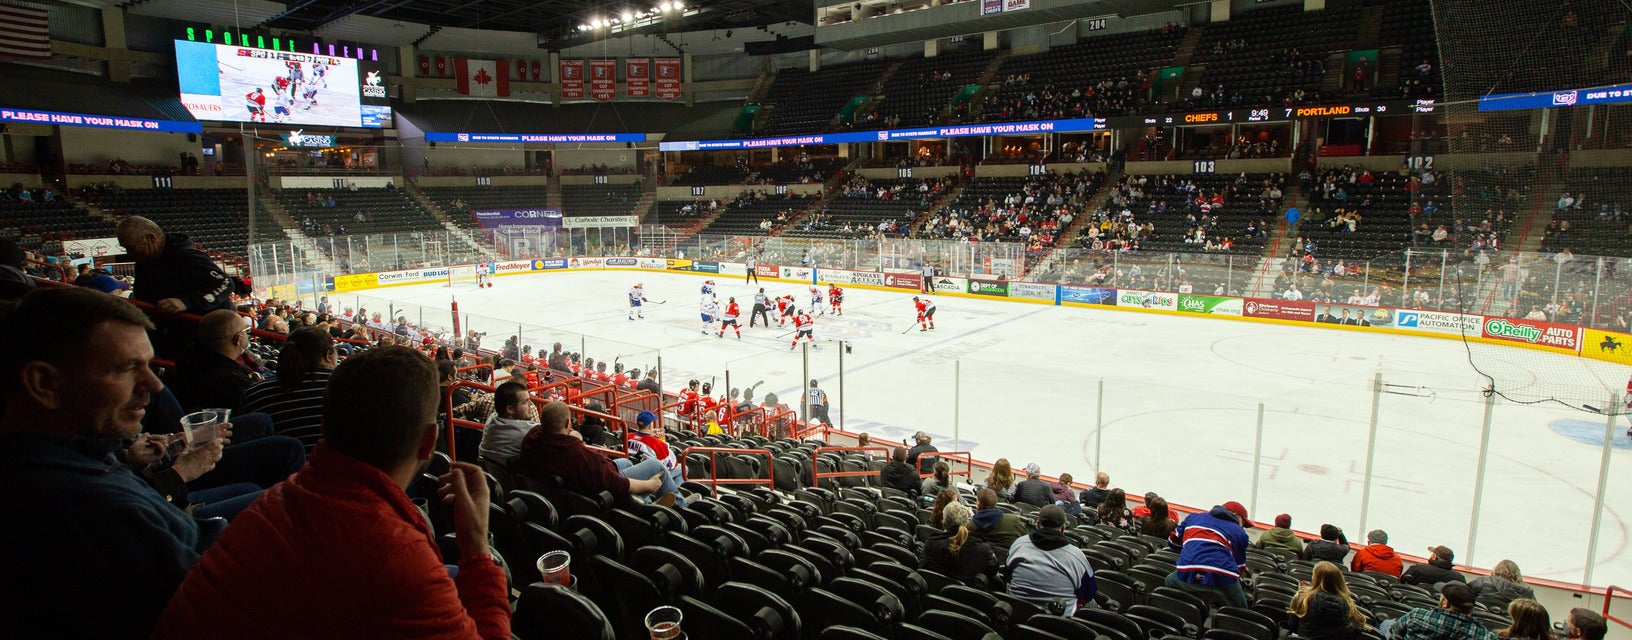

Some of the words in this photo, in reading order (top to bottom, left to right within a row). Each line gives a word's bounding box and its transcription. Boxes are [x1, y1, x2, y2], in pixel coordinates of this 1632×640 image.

[1089, 20, 1106, 30] 204
[186, 27, 295, 53] SPOKANE
[314, 42, 378, 62] ARENA
[1251, 109, 1269, 117] 9:49
[1285, 109, 1292, 117] 7
[1297, 106, 1350, 116] PORTLAND
[2, 111, 50, 122] PLEASE
[51, 114, 82, 124] HAVE
[84, 116, 114, 126] YOUR
[115, 119, 143, 128] MASK
[1185, 114, 1218, 123] CHIEFS
[1228, 112, 1232, 120] 1
[940, 128, 969, 136] PLEASE
[1195, 161, 1214, 173] 103
[1407, 157, 1433, 169] 102
[899, 169, 912, 177] 105
[1030, 166, 1046, 175] 104
[155, 176, 172, 188] 111
[851, 277, 883, 285] AZTECA
[1121, 296, 1144, 304] CUTS
[1152, 296, 1172, 306] KIDS
[1184, 299, 1204, 308] CHAS
[1420, 314, 1449, 322] PACIFIC
[1420, 321, 1475, 330] AUTOMATION
[1488, 320, 1539, 341] O'Reilly
[1546, 327, 1573, 338] AUTO
[1542, 335, 1574, 347] PARTS
